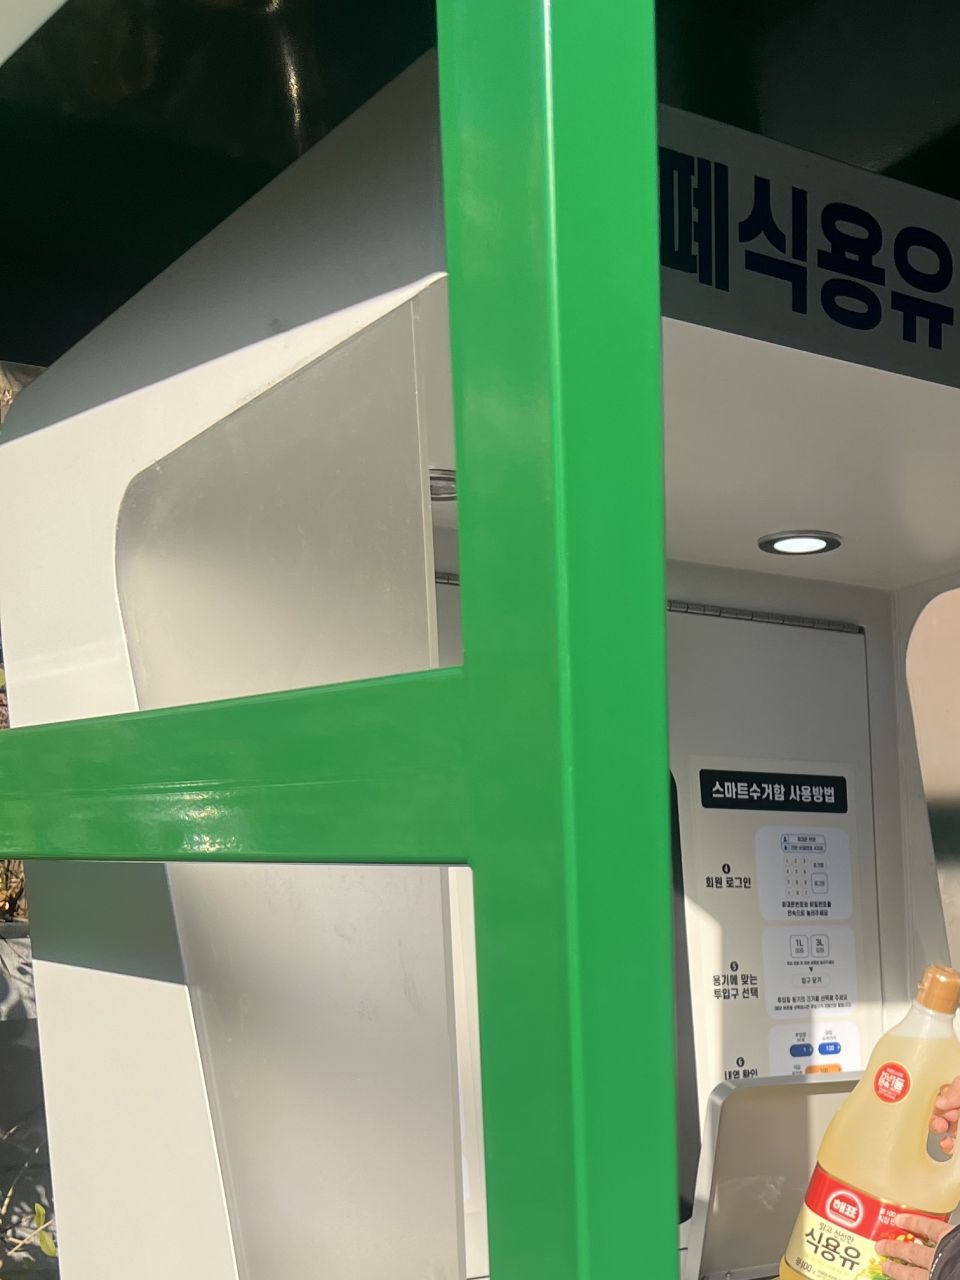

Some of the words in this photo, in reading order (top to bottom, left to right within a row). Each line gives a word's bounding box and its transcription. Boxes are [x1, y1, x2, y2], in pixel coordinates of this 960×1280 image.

[660, 147, 954, 350] 폐식용유
[712, 780, 785, 801] 스마트수거함
[789, 785, 835, 804] 사용방법
[705, 876, 723, 888] 회원
[726, 876, 751, 889] 로그인
[795, 938, 804, 947] 1L
[713, 974, 738, 986] 용기에
[741, 973, 758, 985] 맞는
[714, 987, 739, 999] 투입구
[742, 986, 759, 998] 선택
[832, 1198, 858, 1219] 해표
[805, 1228, 861, 1271] 식용유
